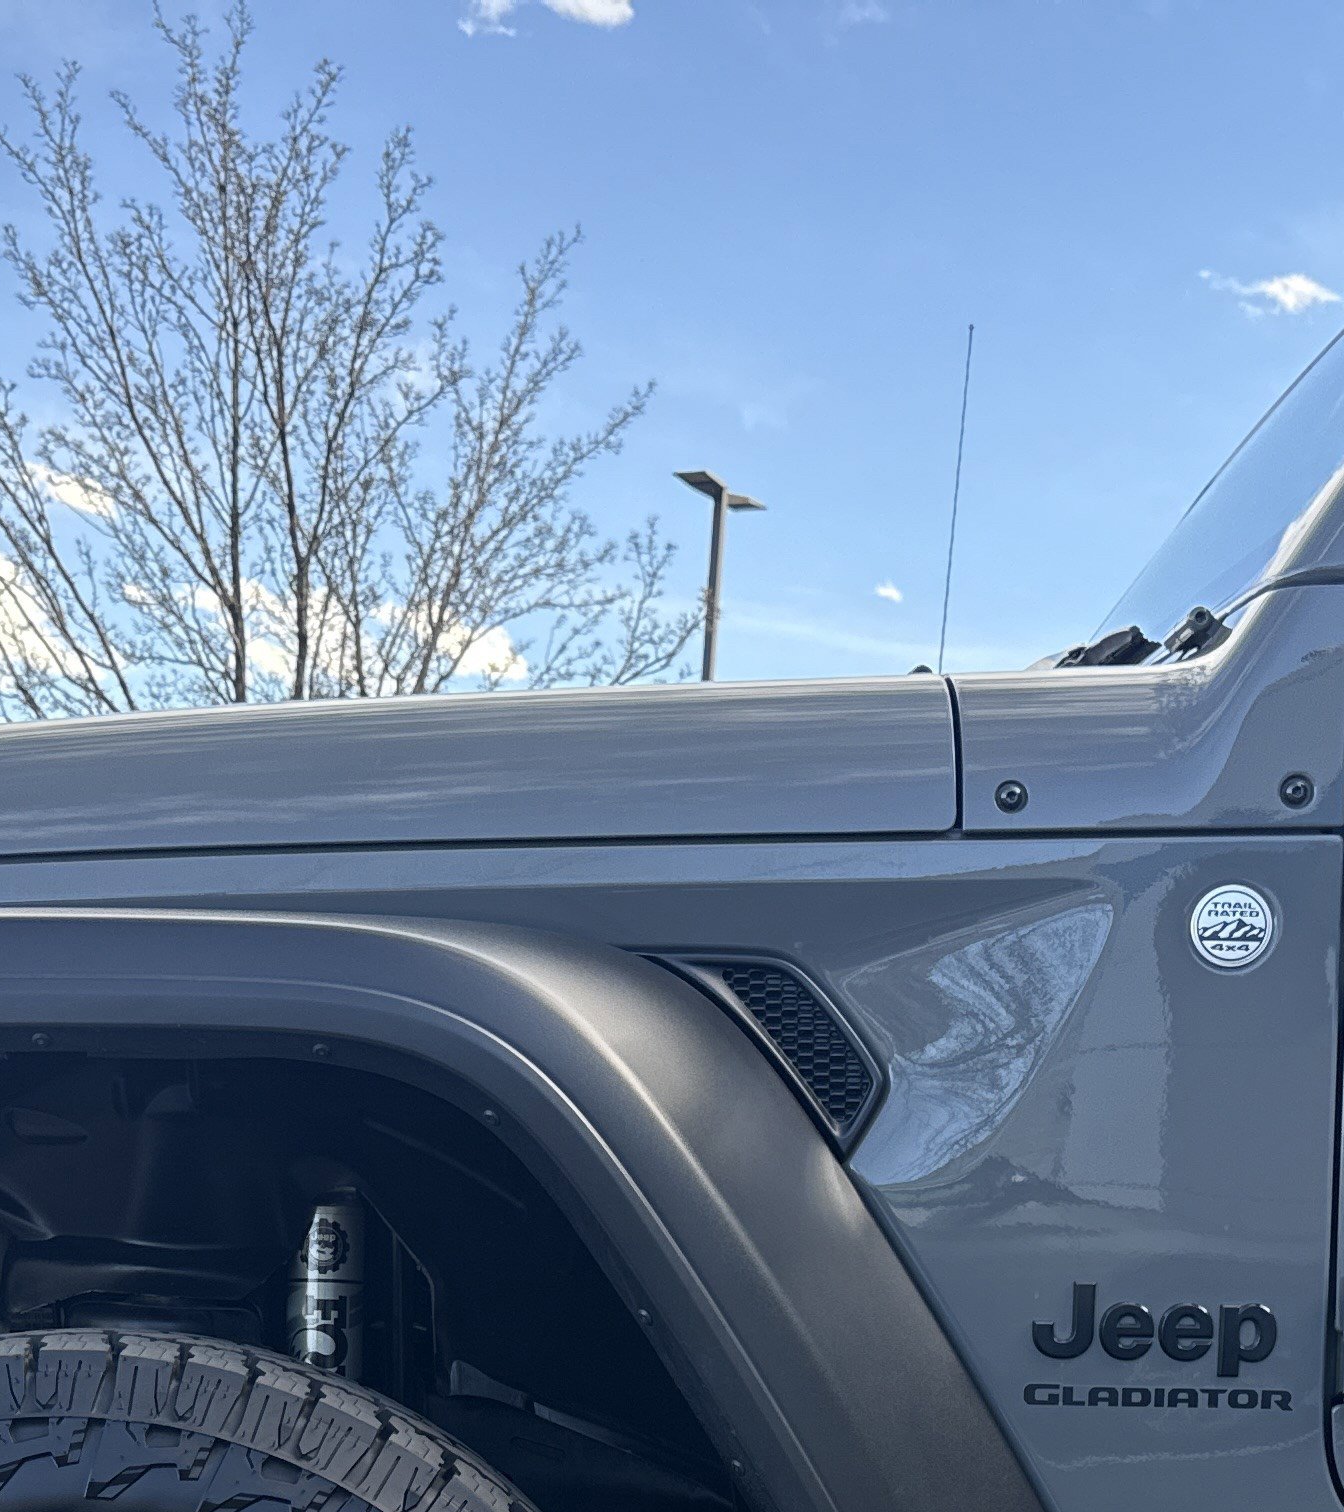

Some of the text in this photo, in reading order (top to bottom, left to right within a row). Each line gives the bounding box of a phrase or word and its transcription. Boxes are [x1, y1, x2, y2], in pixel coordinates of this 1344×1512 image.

[310, 1232, 337, 1243] Jeep
[1032, 1281, 1277, 1377] Jeep
[1023, 1383, 1293, 1411] GLADIATOR
